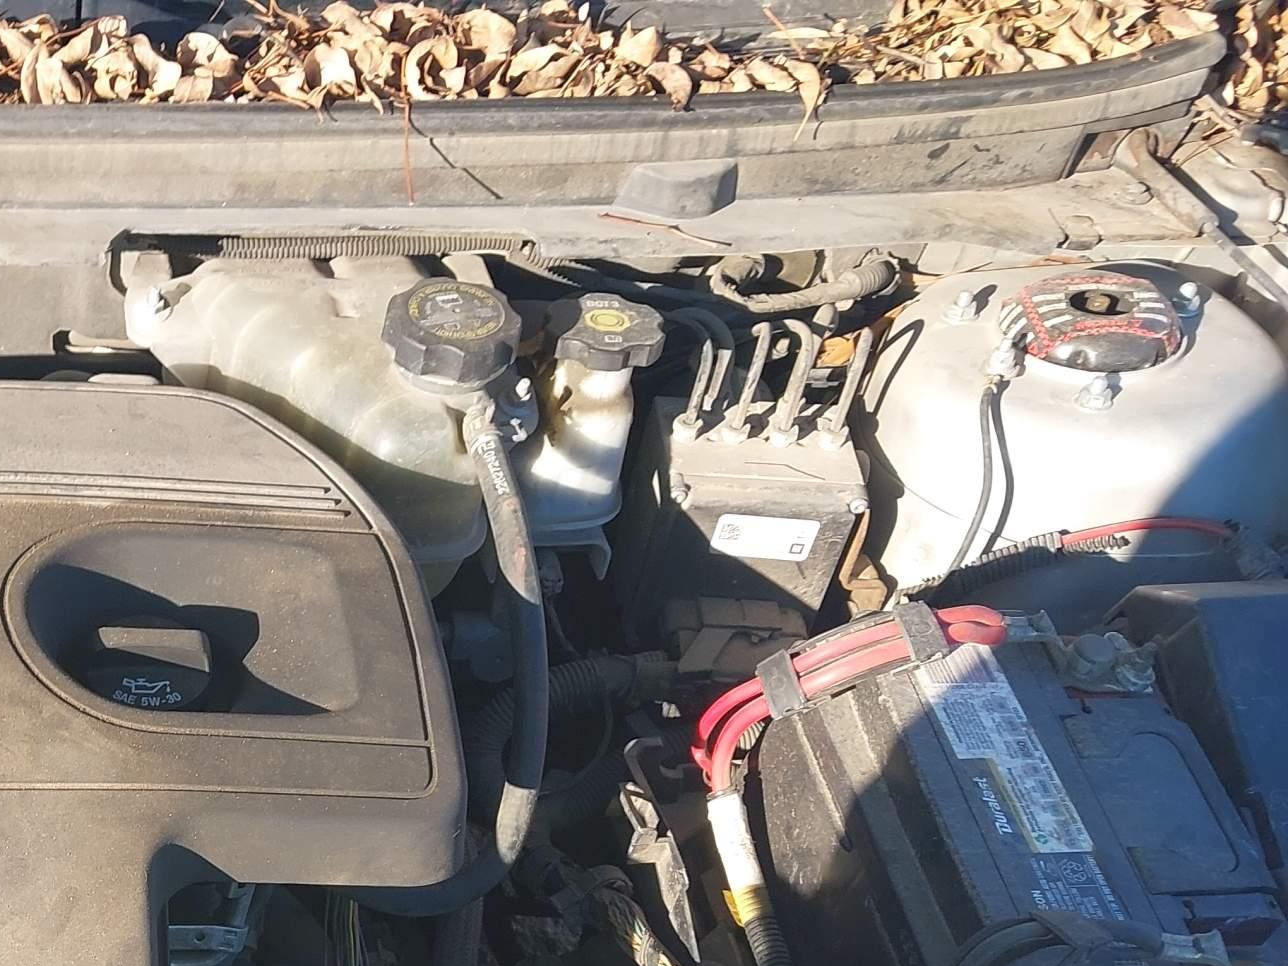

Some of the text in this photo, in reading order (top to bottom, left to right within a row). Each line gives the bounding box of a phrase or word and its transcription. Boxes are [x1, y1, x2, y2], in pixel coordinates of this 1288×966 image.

[112, 690, 182, 706] SAE 5W-30
[972, 776, 1013, 836] Duralast
